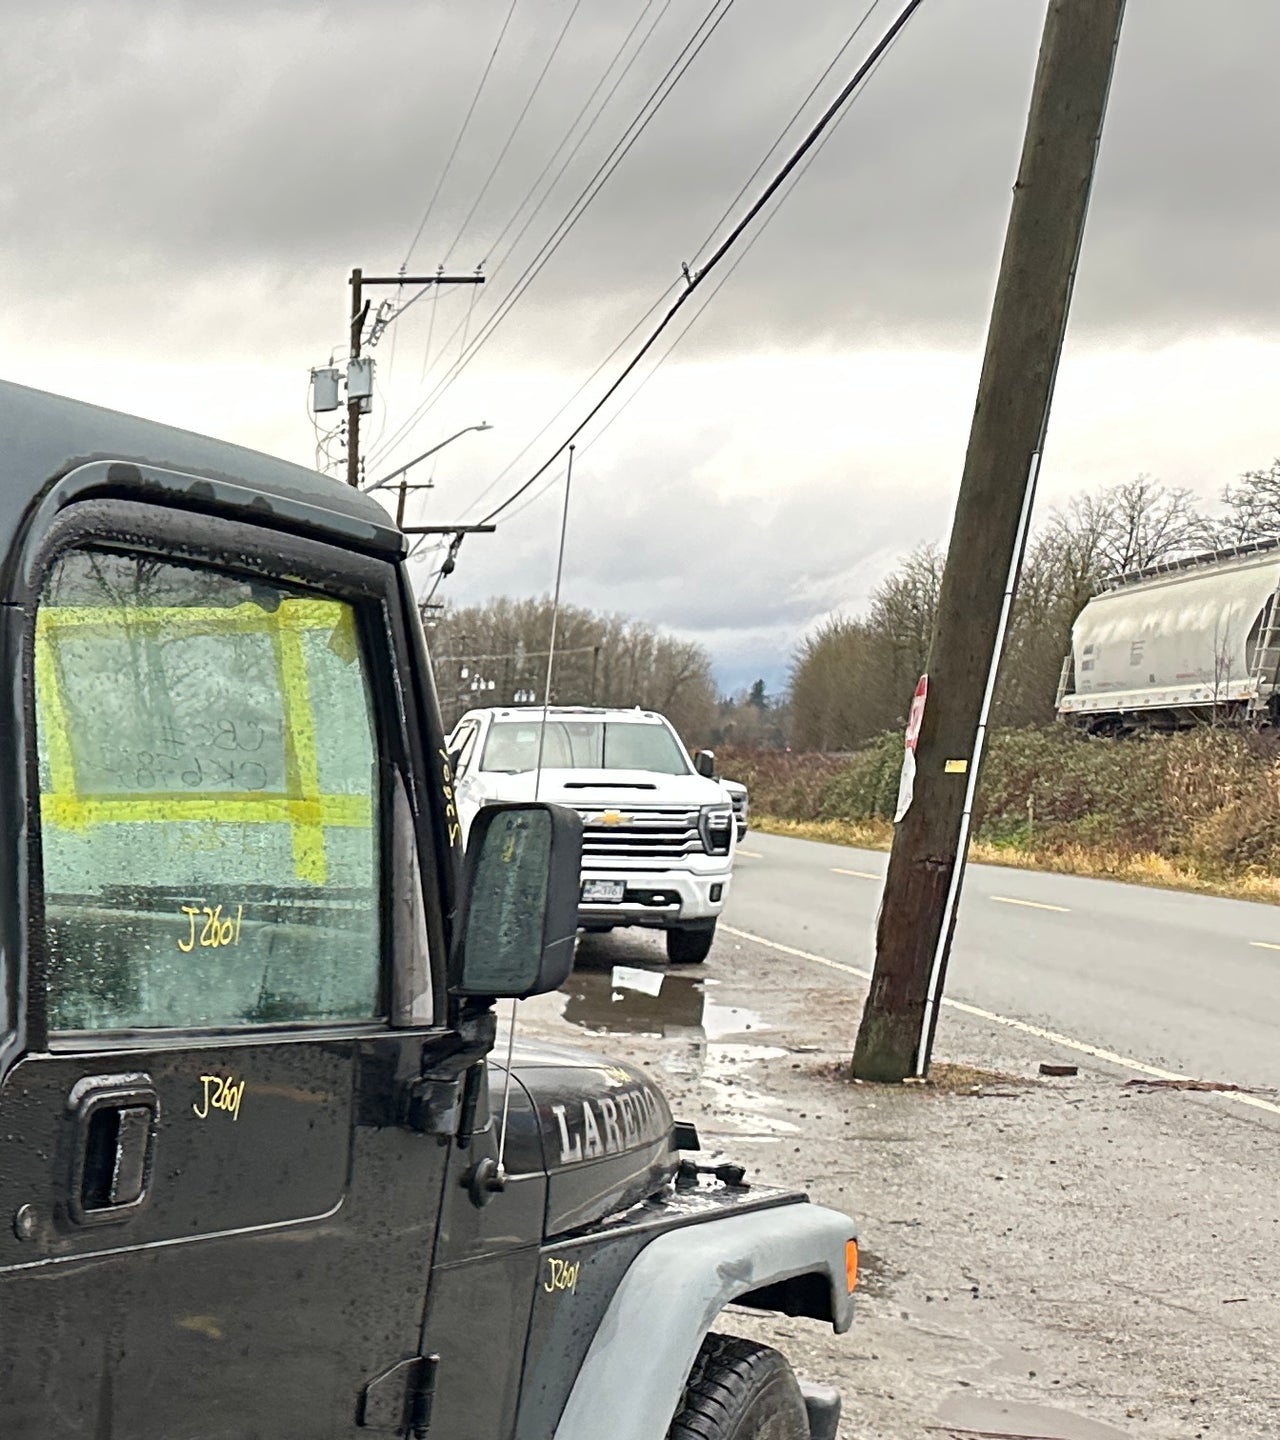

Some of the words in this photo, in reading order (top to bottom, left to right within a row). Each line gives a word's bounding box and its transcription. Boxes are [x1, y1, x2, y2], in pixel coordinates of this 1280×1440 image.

[178, 904, 243, 953] J2601
[193, 1074, 246, 1123] J2601
[543, 1257, 580, 1295] J2601
